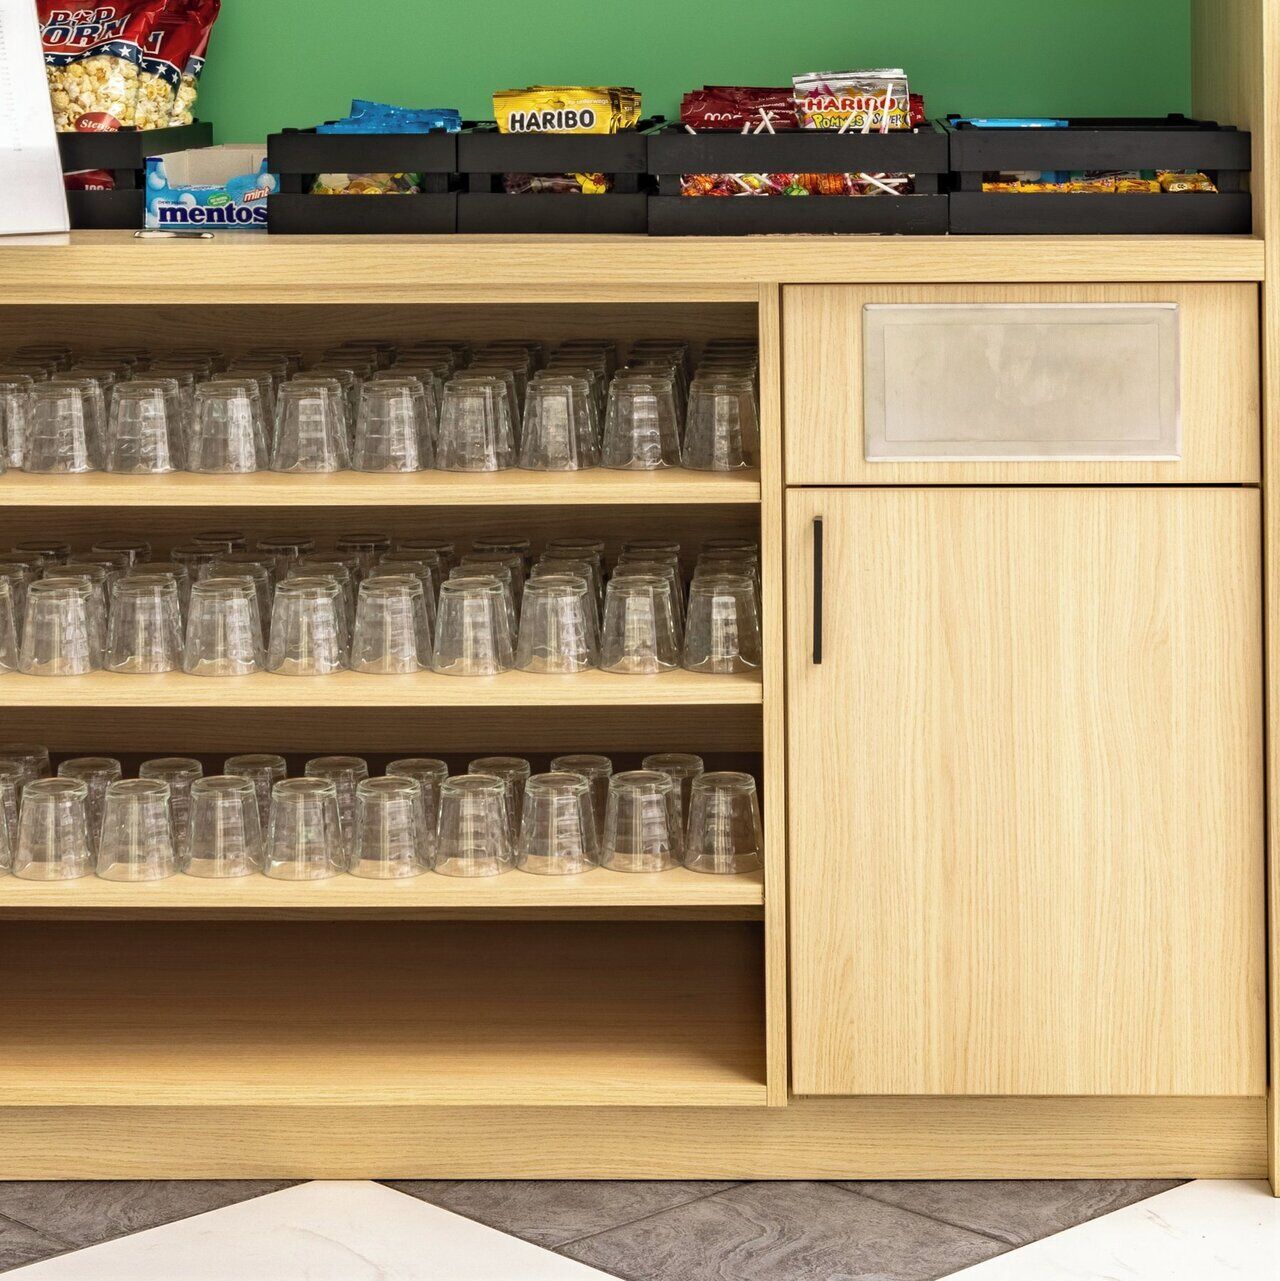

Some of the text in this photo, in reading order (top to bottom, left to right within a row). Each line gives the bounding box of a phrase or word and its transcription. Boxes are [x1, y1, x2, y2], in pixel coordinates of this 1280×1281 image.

[41, 13, 131, 47] ORN
[806, 97, 897, 111] HARIBO
[510, 109, 595, 131] HARIBO
[243, 186, 269, 202] mint
[158, 202, 267, 223] mentos
